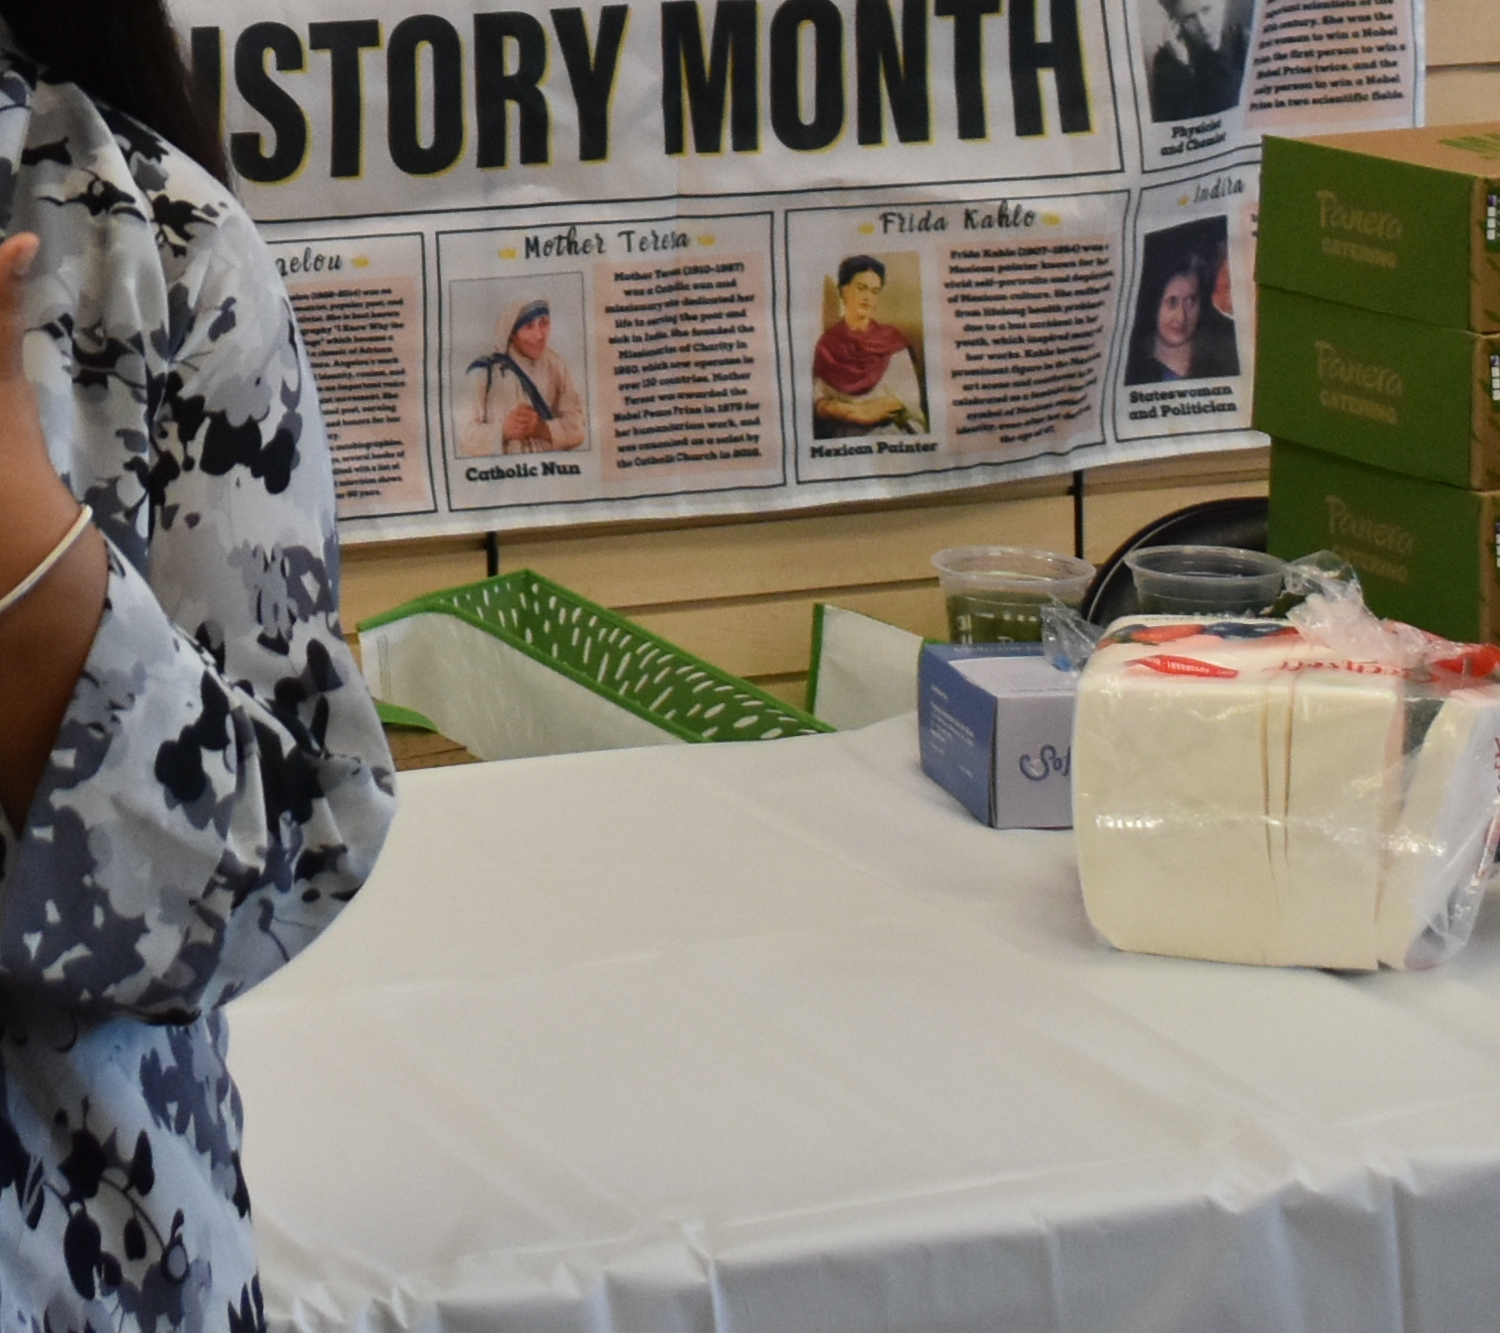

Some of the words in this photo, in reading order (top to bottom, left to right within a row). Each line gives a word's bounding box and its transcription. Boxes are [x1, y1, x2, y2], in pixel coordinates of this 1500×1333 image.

[189, 4, 630, 185] ISTORY
[1193, 176, 1245, 203] Indira
[879, 211, 949, 234] Frida
[964, 199, 1037, 229] Kahlo
[1315, 189, 1403, 240] Panera
[523, 226, 605, 260] Mother
[617, 229, 691, 253] Teresa
[1314, 340, 1403, 397] Panera
[1129, 386, 1233, 403] Stateswoman
[1129, 405, 1157, 420] and
[1161, 401, 1237, 418] Politician
[810, 443, 873, 460] Mexican
[877, 439, 938, 456] Painter
[465, 466, 538, 483] Catholic
[541, 462, 580, 476] Nun
